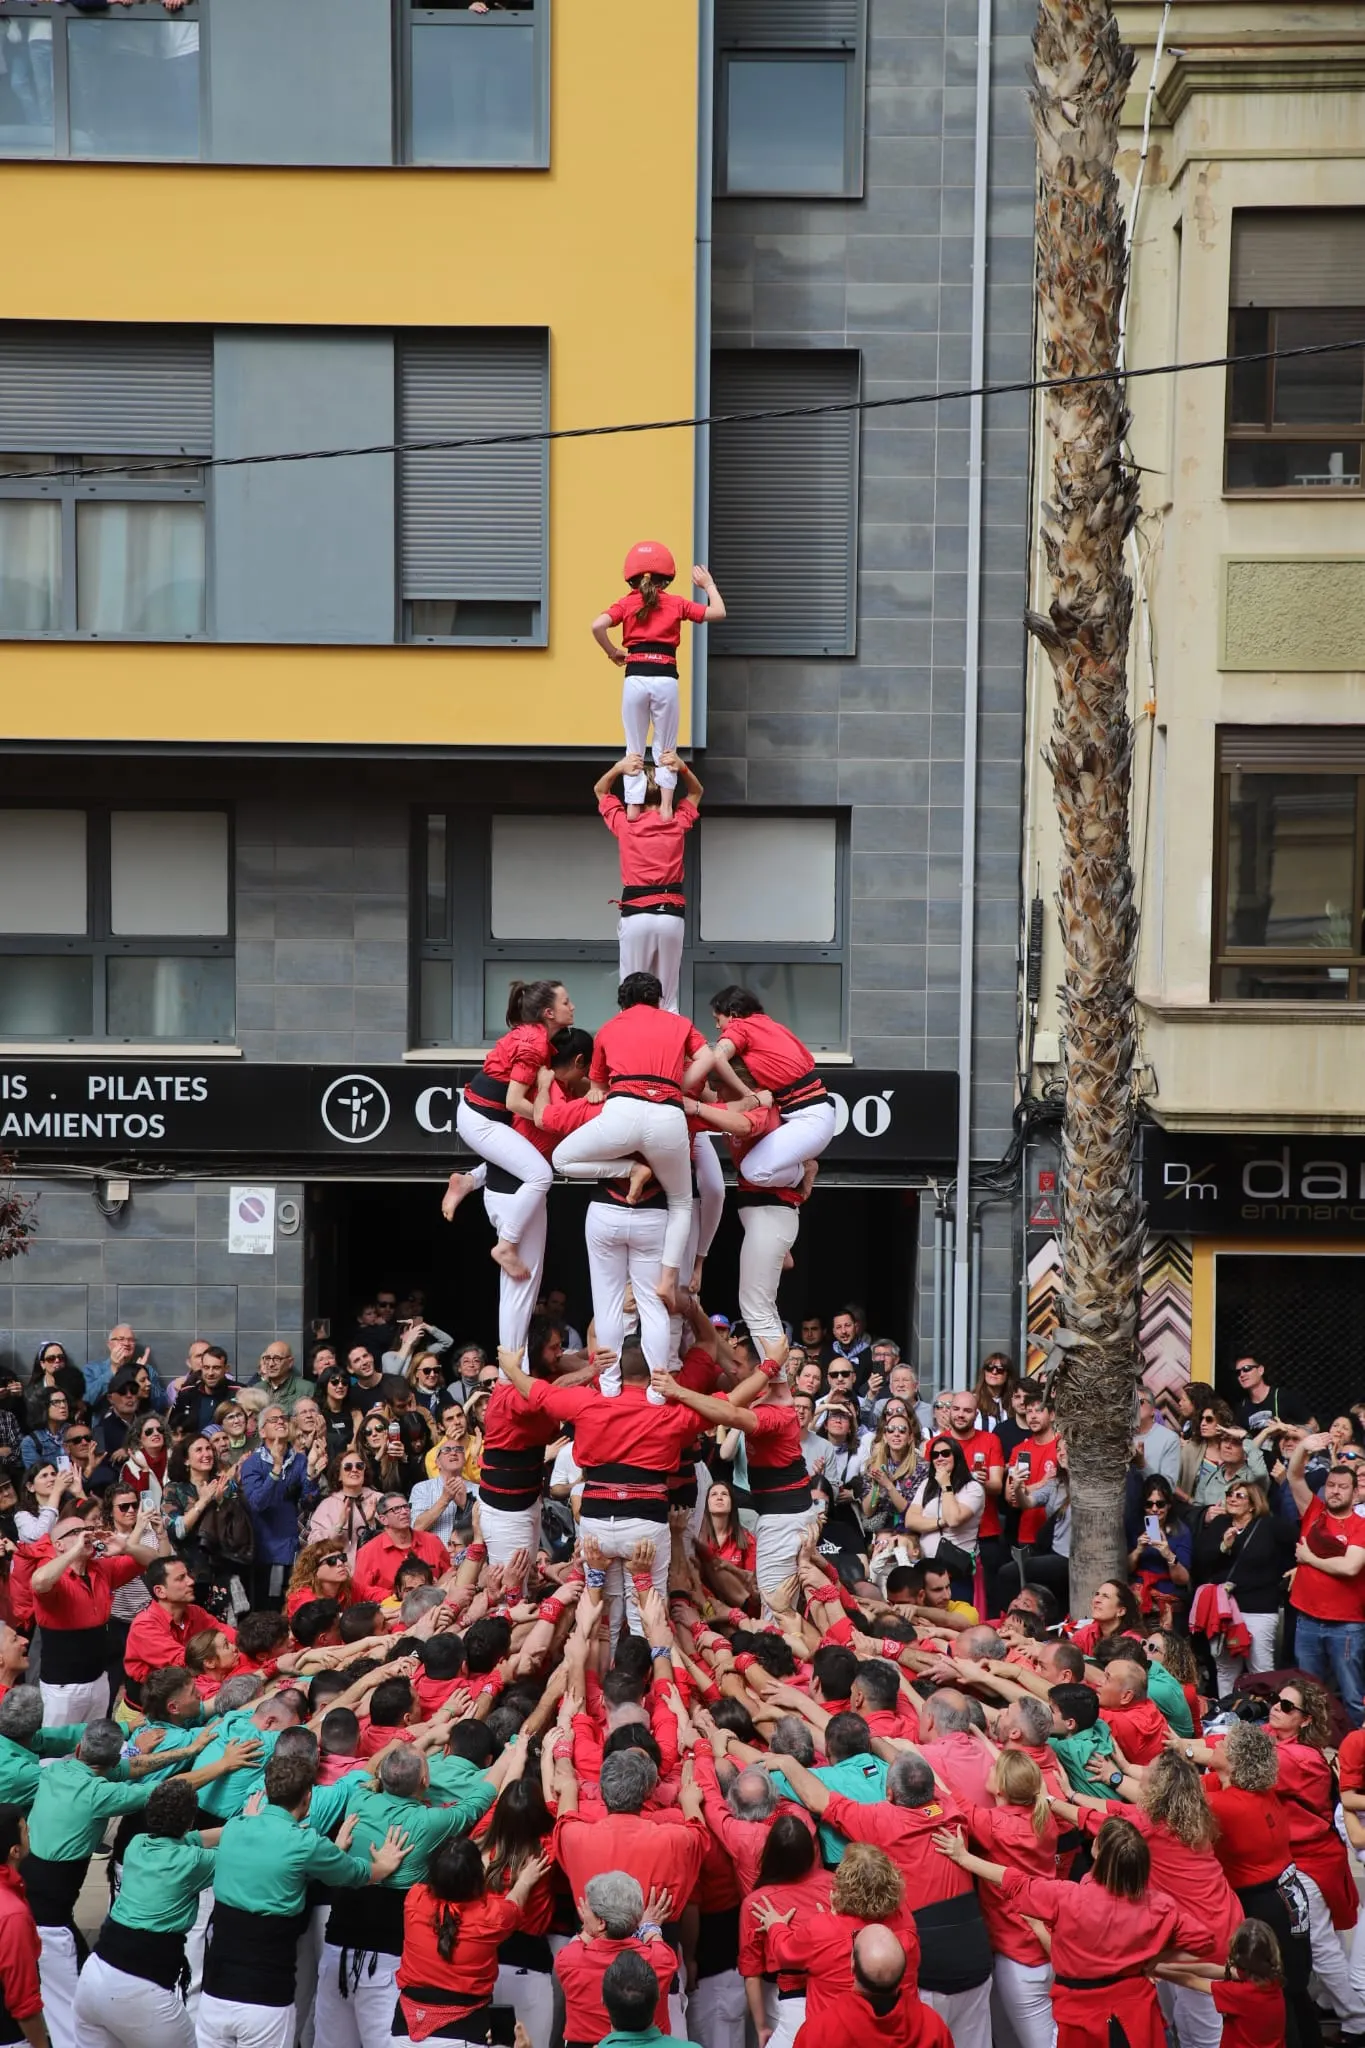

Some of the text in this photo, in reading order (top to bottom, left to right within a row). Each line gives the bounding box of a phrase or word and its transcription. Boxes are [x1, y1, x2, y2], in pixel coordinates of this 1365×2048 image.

[2, 1074, 28, 1100] IS
[88, 1075, 208, 1102] PILATES
[1, 1112, 165, 1139] AMIENTOS
[1242, 1146, 1365, 1200] da
[278, 1200, 300, 1236] 9
